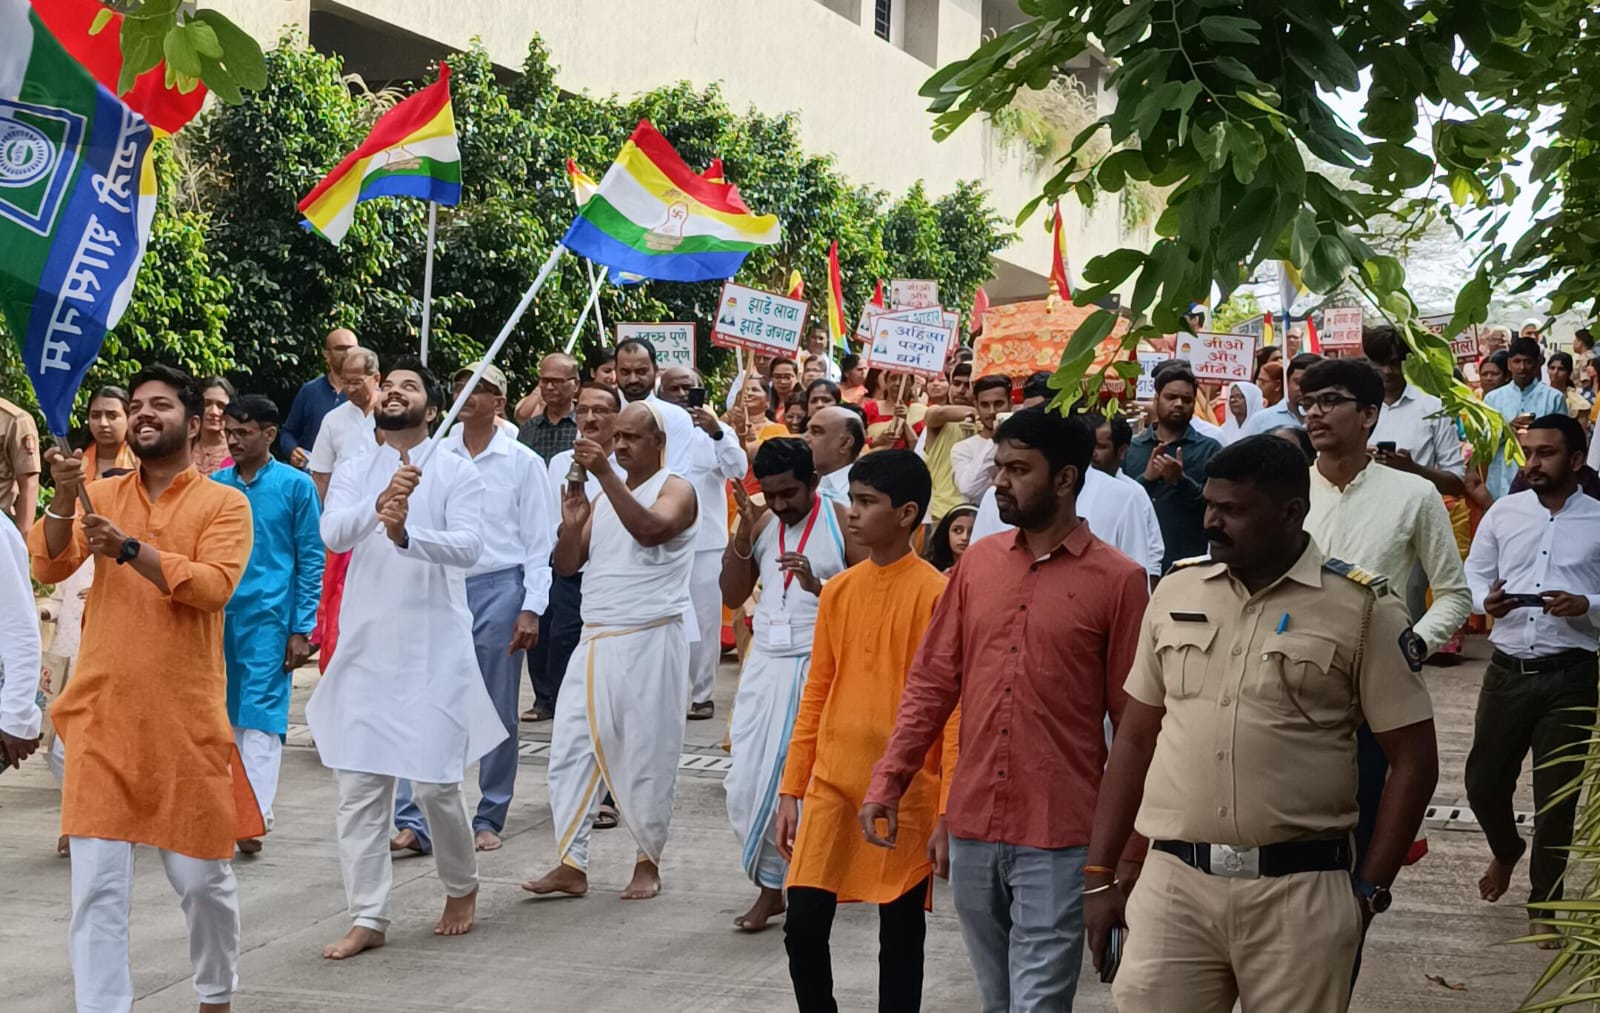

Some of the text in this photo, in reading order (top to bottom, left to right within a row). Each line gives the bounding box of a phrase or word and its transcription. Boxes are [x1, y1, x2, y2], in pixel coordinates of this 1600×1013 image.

[748, 296, 800, 321] झाडे लावा
[669, 328, 687, 347] पुणे
[740, 317, 763, 336] झाडे
[766, 324, 797, 344] जगवा
[1203, 337, 1244, 351] जीओ
[1207, 350, 1237, 363] और
[1195, 361, 1248, 376] जीने दो
